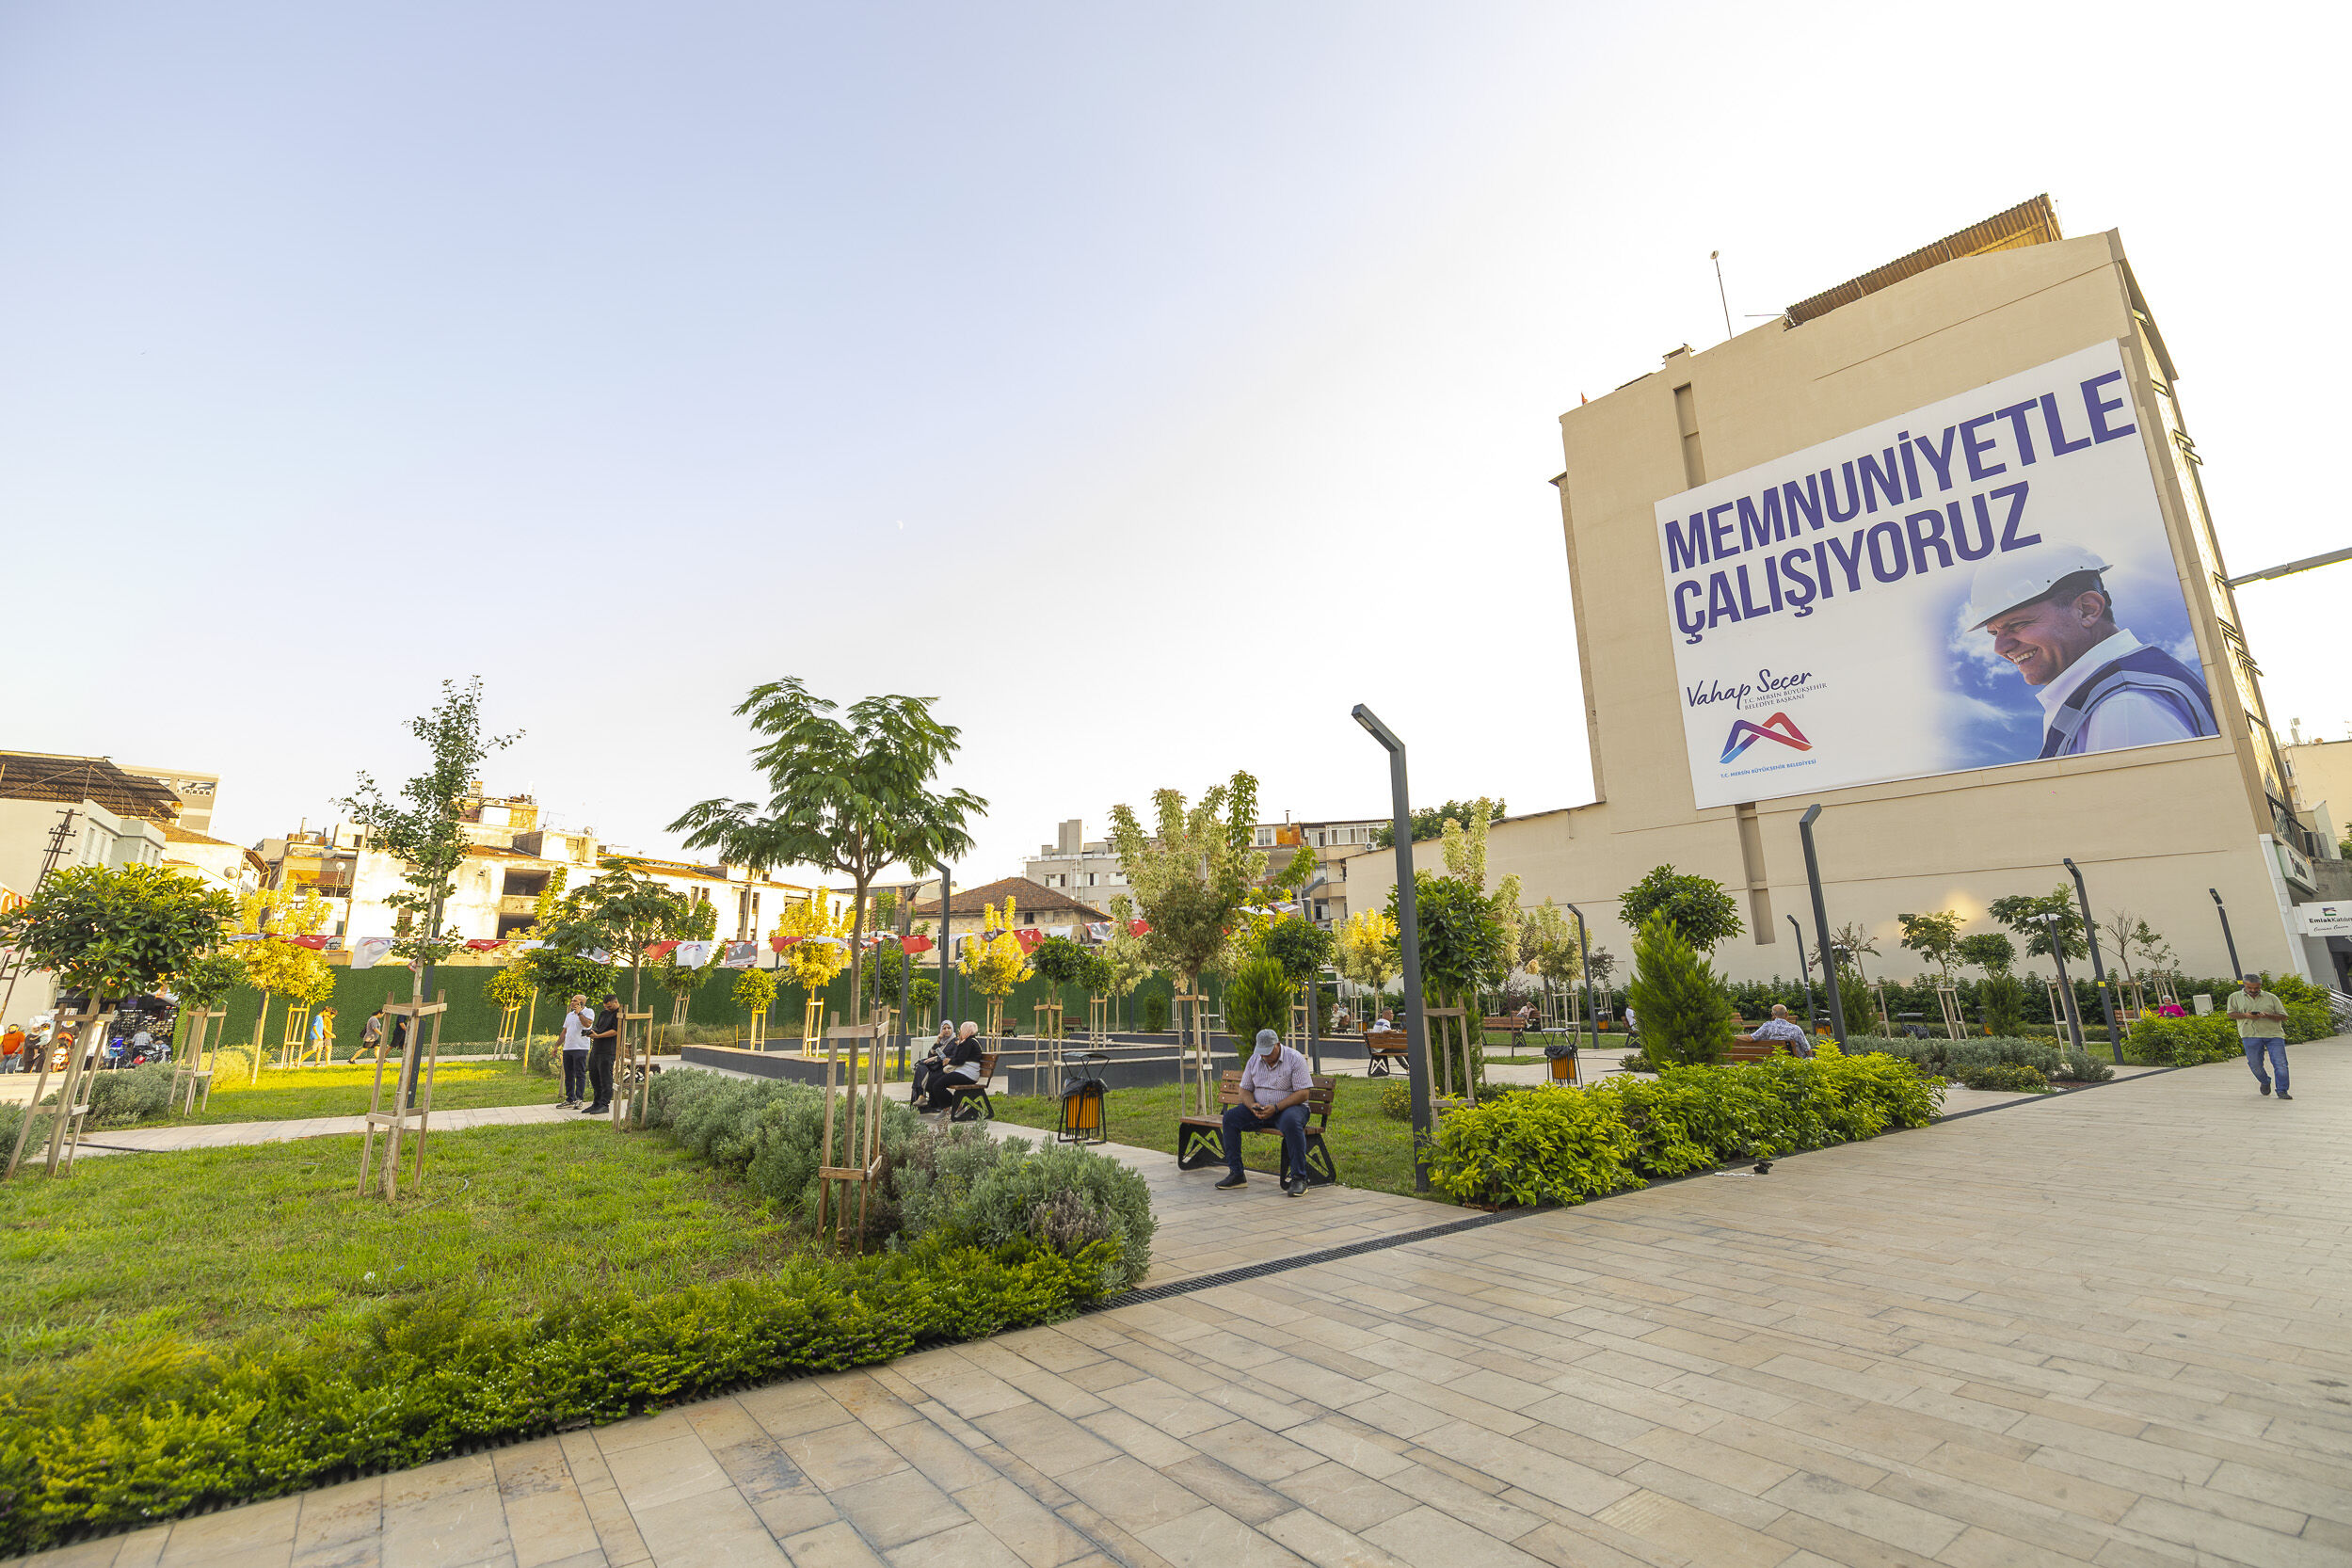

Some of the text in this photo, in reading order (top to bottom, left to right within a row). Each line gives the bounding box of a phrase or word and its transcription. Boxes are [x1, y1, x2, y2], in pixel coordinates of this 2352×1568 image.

[1665, 370, 2136, 573] MEMNUNİYETLE
[1673, 481, 2042, 645] ÇALIŞIYORUZ
[1687, 668, 1813, 710] Vahap Seçer
[1744, 694, 1805, 711] BELEDİYE BAŞKANI
[1756, 692, 1782, 702] MERSİN
[1784, 682, 1828, 696] BÜYÜKŞEHİR
[1751, 763, 1785, 774] BÜYÜKŞEHİR
[1786, 759, 1816, 768] BELEDİYESİ
